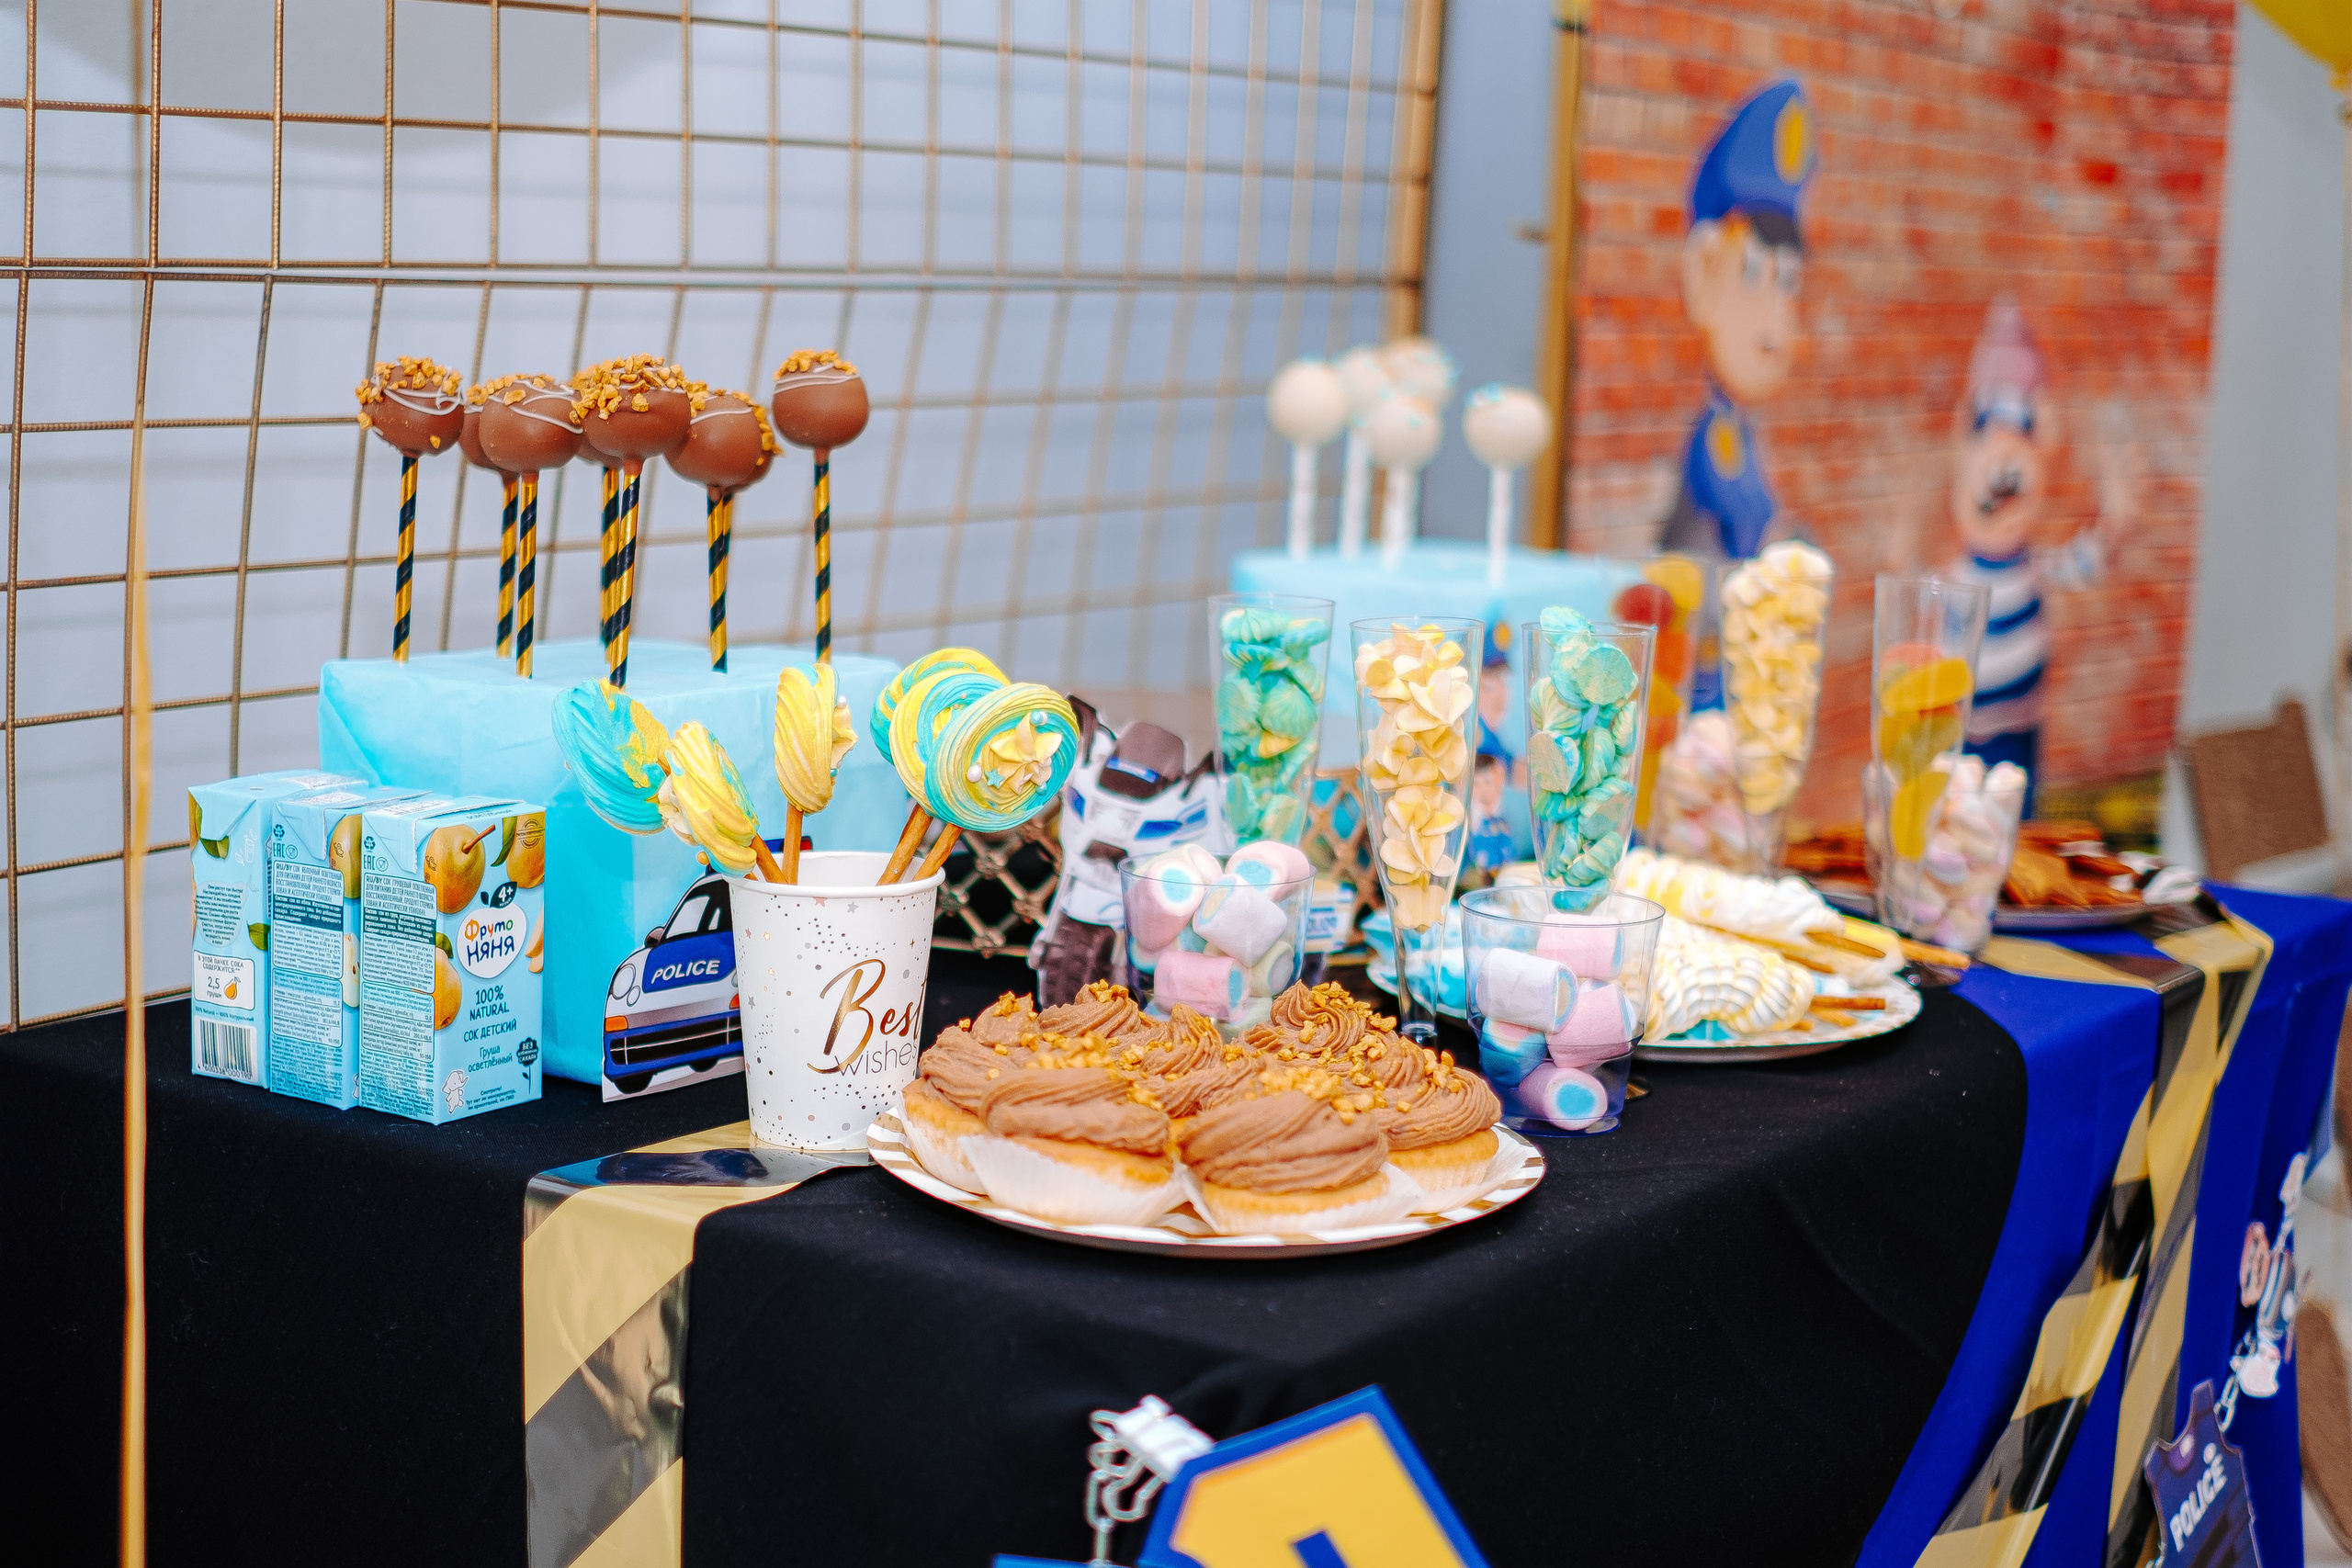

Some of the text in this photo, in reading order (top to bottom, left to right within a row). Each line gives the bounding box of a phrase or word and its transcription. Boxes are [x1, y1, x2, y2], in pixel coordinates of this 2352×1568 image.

[499, 886, 513, 902] 4+
[231, 960, 244, 968] СОКА
[650, 959, 720, 985] POLICE
[208, 976, 220, 989] 2,5
[476, 985, 503, 1005] 100%
[469, 1002, 509, 1021] NATURAL
[807, 959, 928, 1074] Best
[464, 1019, 516, 1043] СОК ДЕТСКИЙ
[480, 1045, 501, 1060] Груша
[469, 1053, 513, 1072] осветлённый
[2169, 1454, 2227, 1552] POLICE
